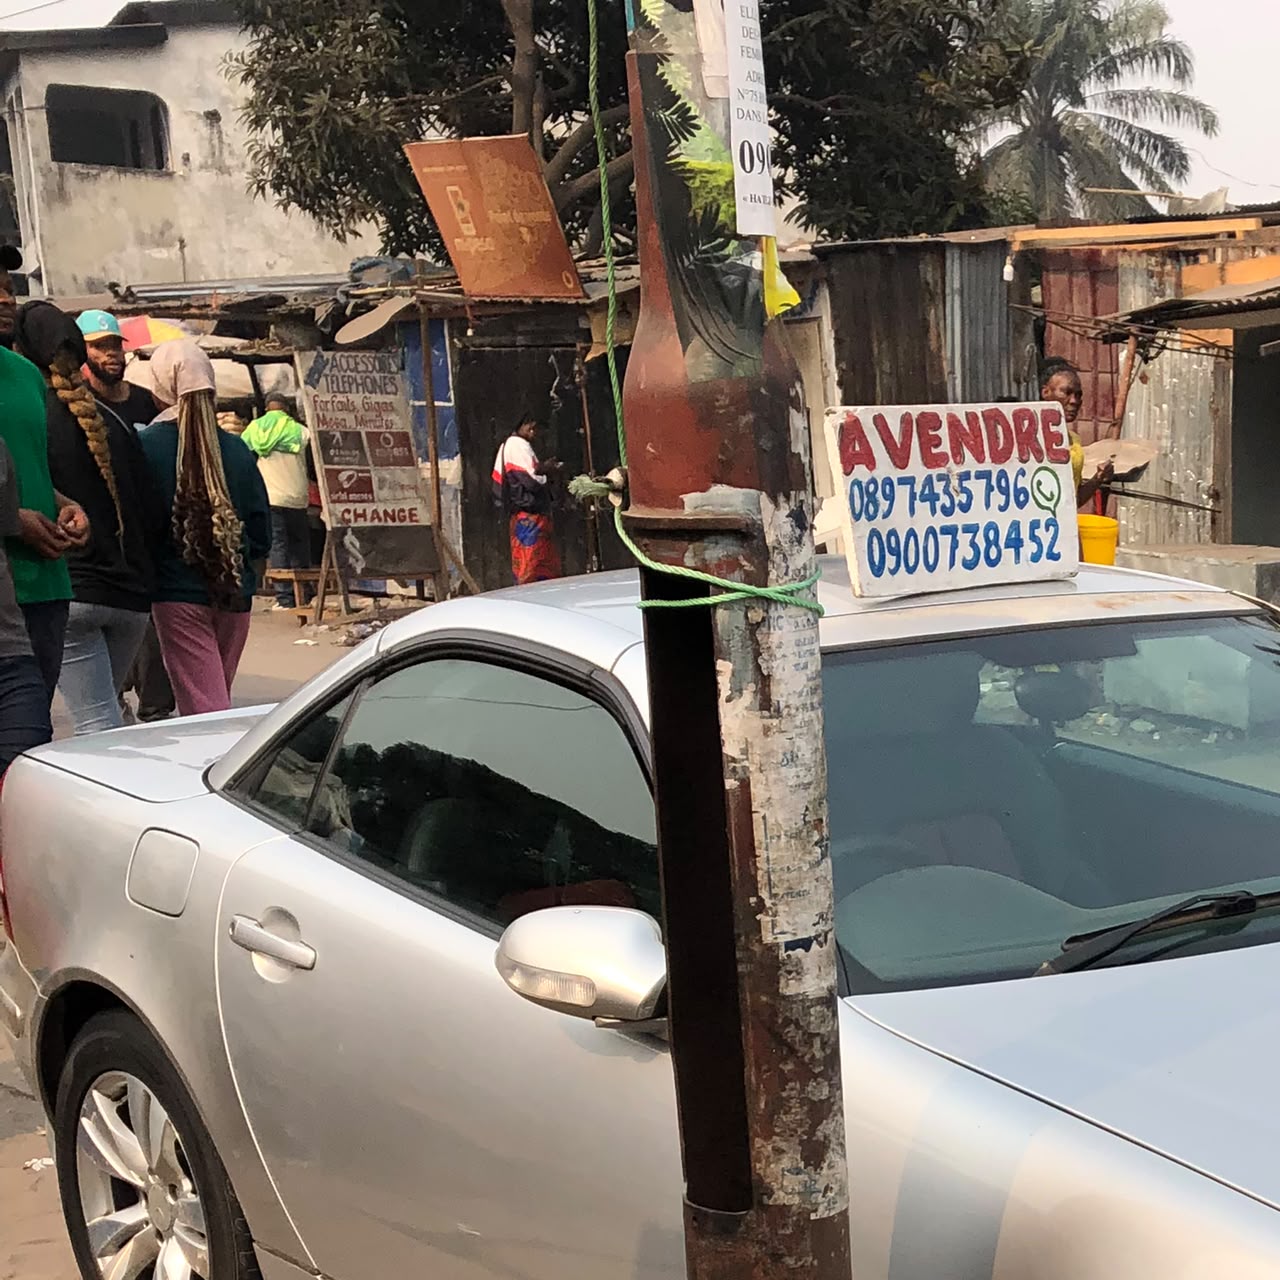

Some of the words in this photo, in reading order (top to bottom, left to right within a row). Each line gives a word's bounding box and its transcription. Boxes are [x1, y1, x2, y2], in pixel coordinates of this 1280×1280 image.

[341, 507, 419, 524] CHANGE
[849, 466, 1030, 523] 0897435796
[867, 517, 1061, 578] 0900738452
